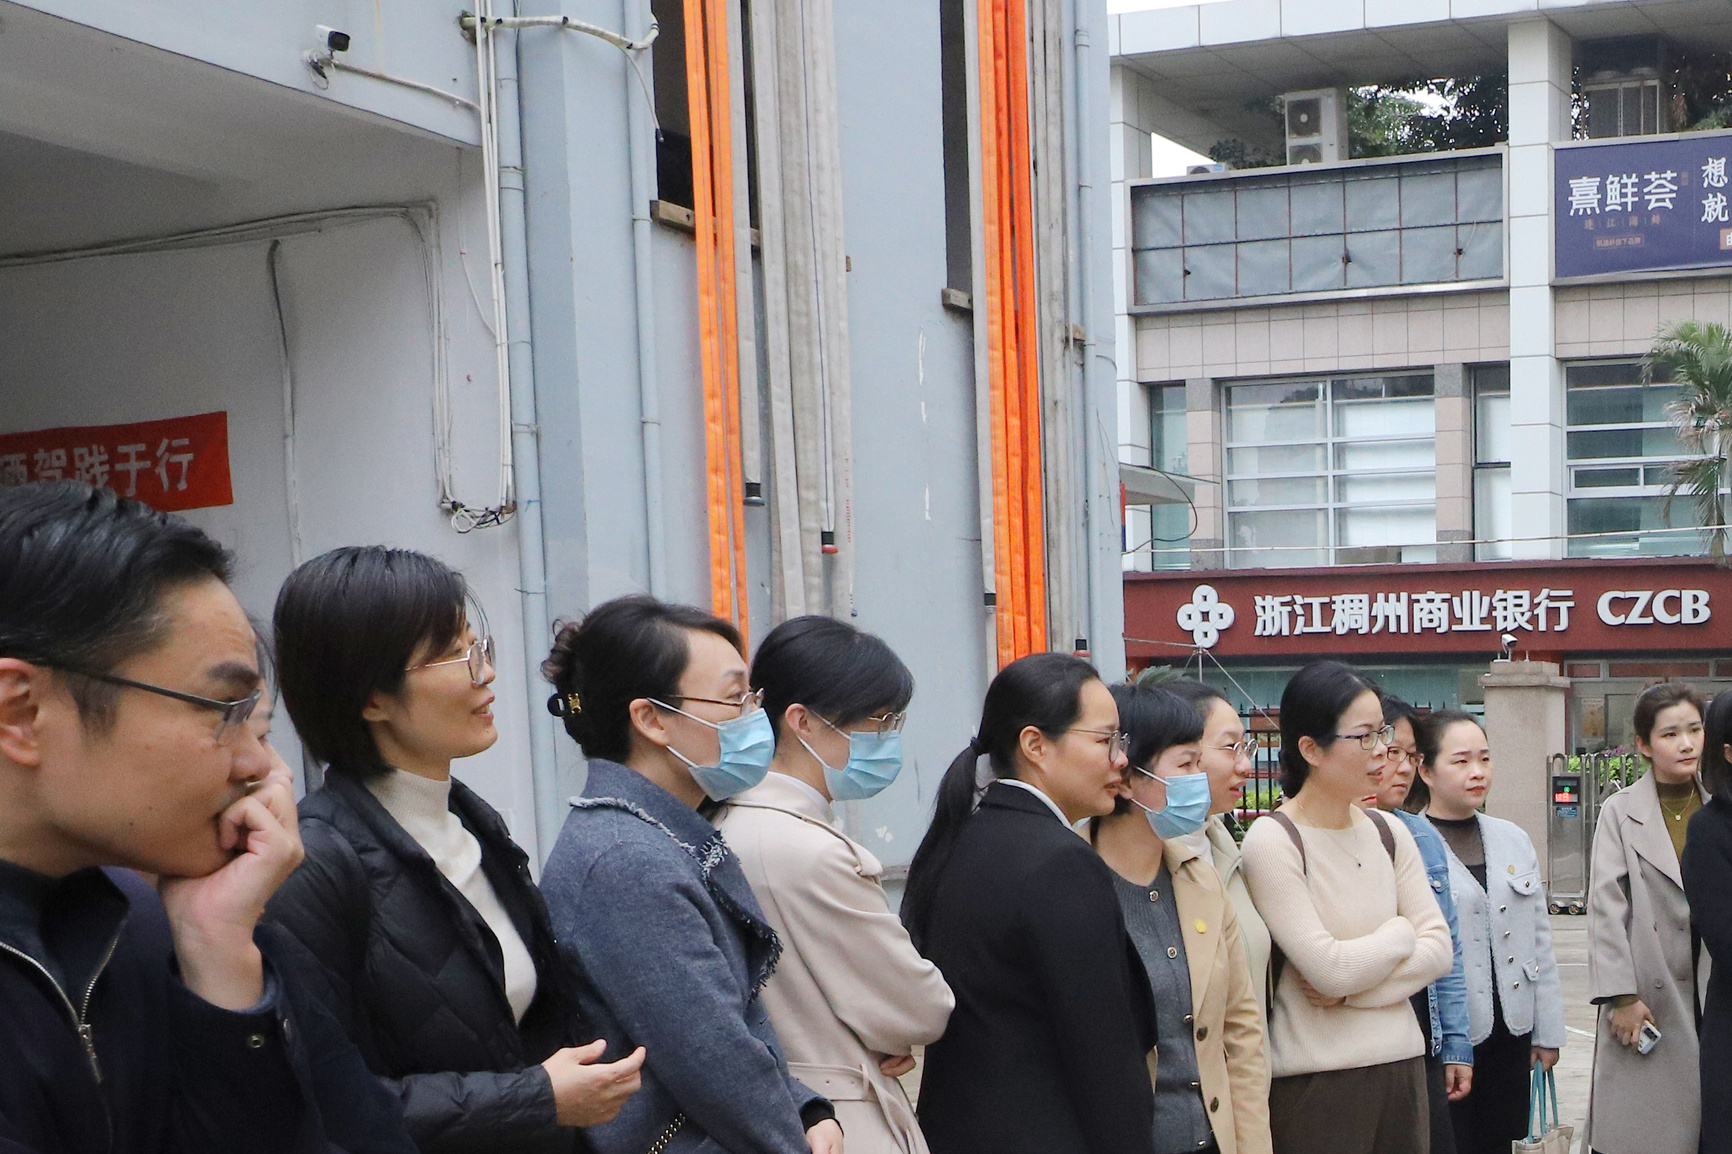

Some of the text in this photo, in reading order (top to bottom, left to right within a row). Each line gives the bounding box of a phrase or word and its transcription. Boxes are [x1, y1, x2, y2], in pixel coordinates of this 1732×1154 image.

[1253, 587, 1712, 637] 浙江稠州商业银行 CZCB
